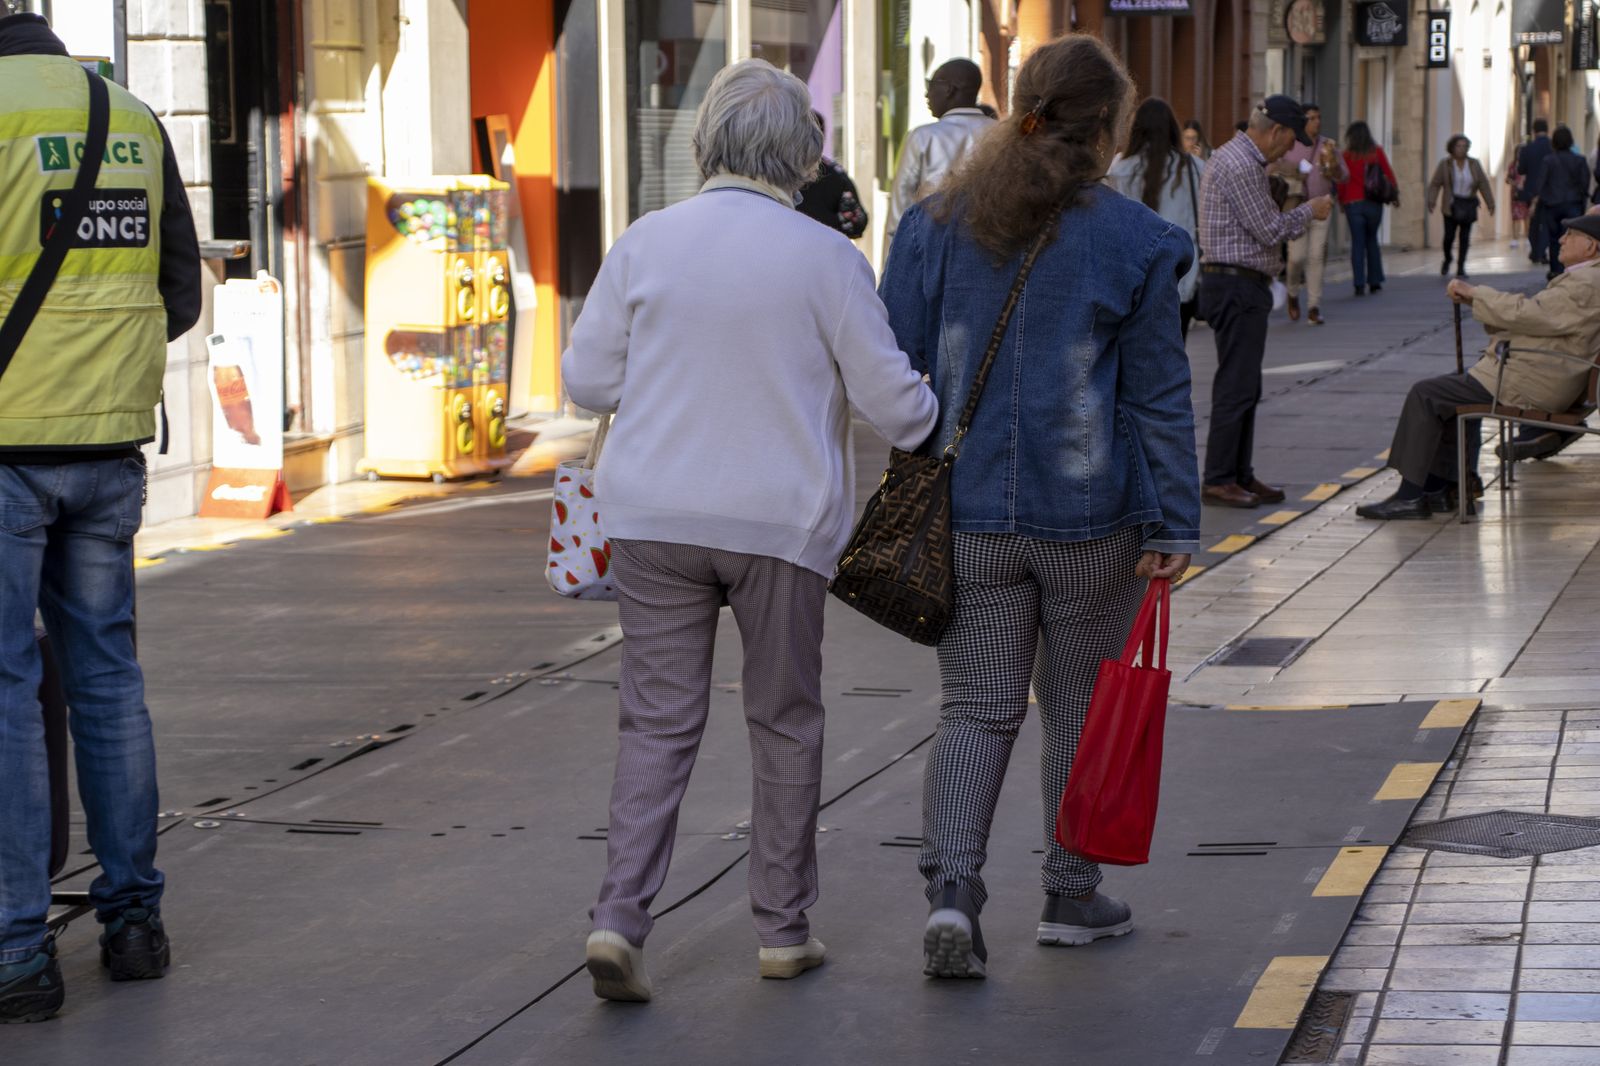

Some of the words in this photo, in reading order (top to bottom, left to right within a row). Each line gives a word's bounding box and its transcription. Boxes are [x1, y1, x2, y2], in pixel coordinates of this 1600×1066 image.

[74, 141, 143, 165] OCE
[89, 199, 115, 214] upo
[117, 196, 147, 211] social
[77, 216, 147, 240] ONCE
